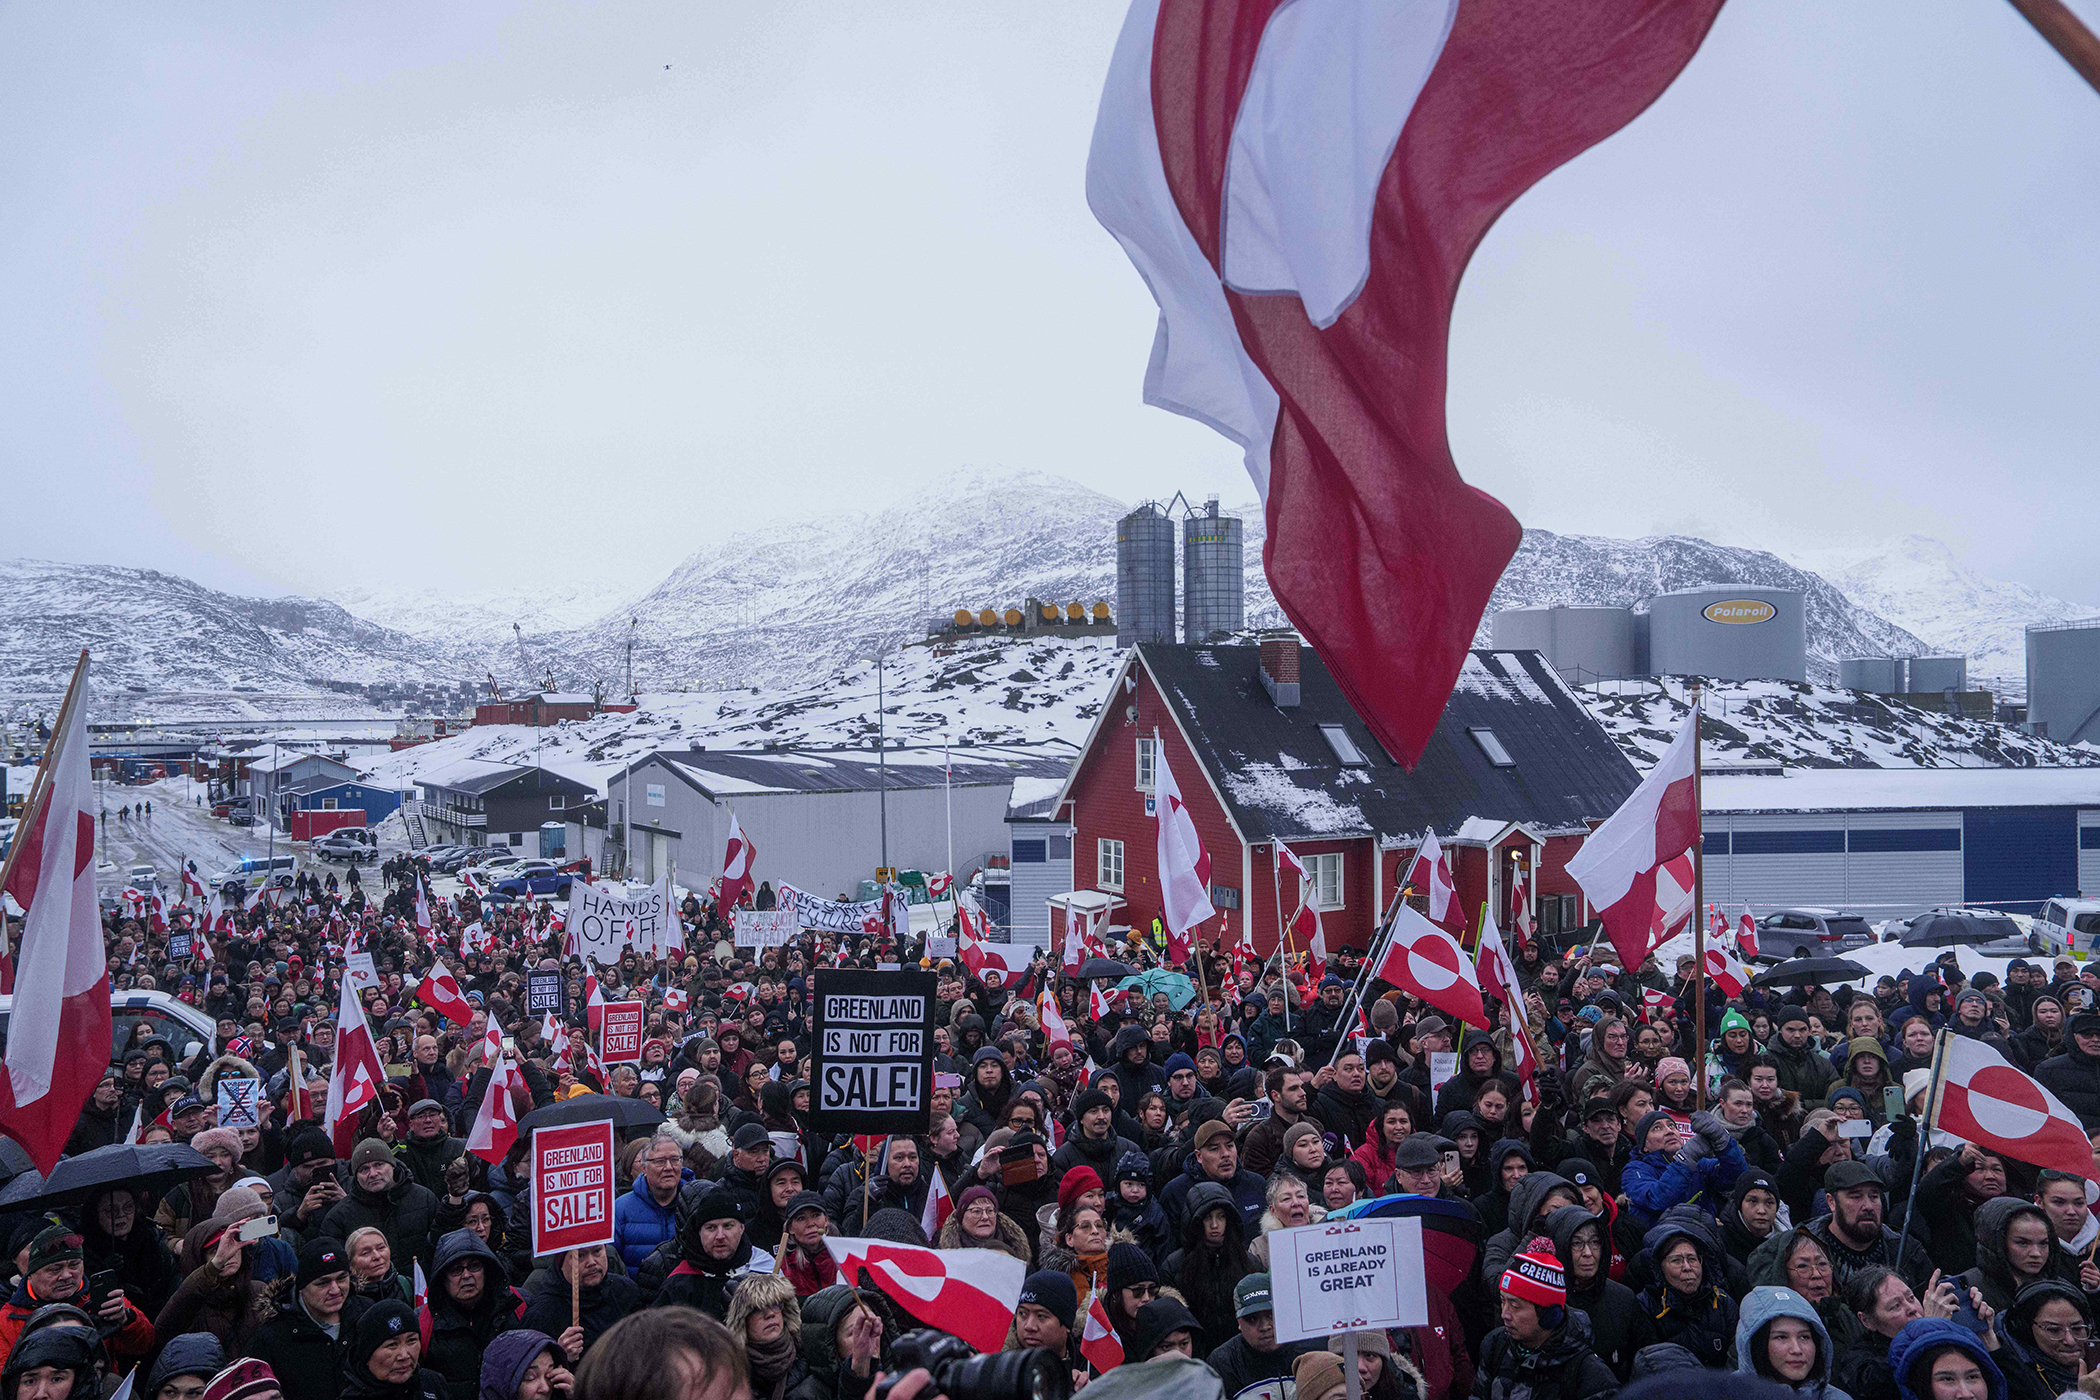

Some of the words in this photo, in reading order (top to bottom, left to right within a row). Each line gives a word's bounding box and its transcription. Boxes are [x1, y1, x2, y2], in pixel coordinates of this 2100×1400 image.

[1713, 606, 1769, 617] Polaroil
[583, 893, 661, 917] HANDS
[741, 912, 755, 927] WE
[776, 912, 794, 926] NOT
[796, 903, 862, 932] FUTURE
[532, 994, 558, 1008] SALE!
[827, 997, 922, 1020] GREENLAND
[608, 1012, 638, 1022] GREENLAND
[608, 1026, 614, 1034] IS
[615, 1024, 626, 1033] NOT
[626, 1023, 638, 1032] FOR
[607, 1035, 637, 1053] SALE!
[826, 1032, 841, 1053] IS
[849, 1032, 882, 1054] NOT
[889, 1032, 920, 1053] FOR
[824, 1065, 919, 1108] SALE!
[545, 1145, 603, 1167] GREENLAND
[546, 1175, 555, 1191] IS
[559, 1171, 580, 1188] NOT
[584, 1167, 603, 1184] FOR
[546, 1190, 604, 1230] SALE!
[1304, 1244, 1387, 1264] GREENLAND
[1307, 1266, 1320, 1278] IS
[1323, 1258, 1387, 1276] ALREADY
[1319, 1274, 1375, 1293] GREAT
